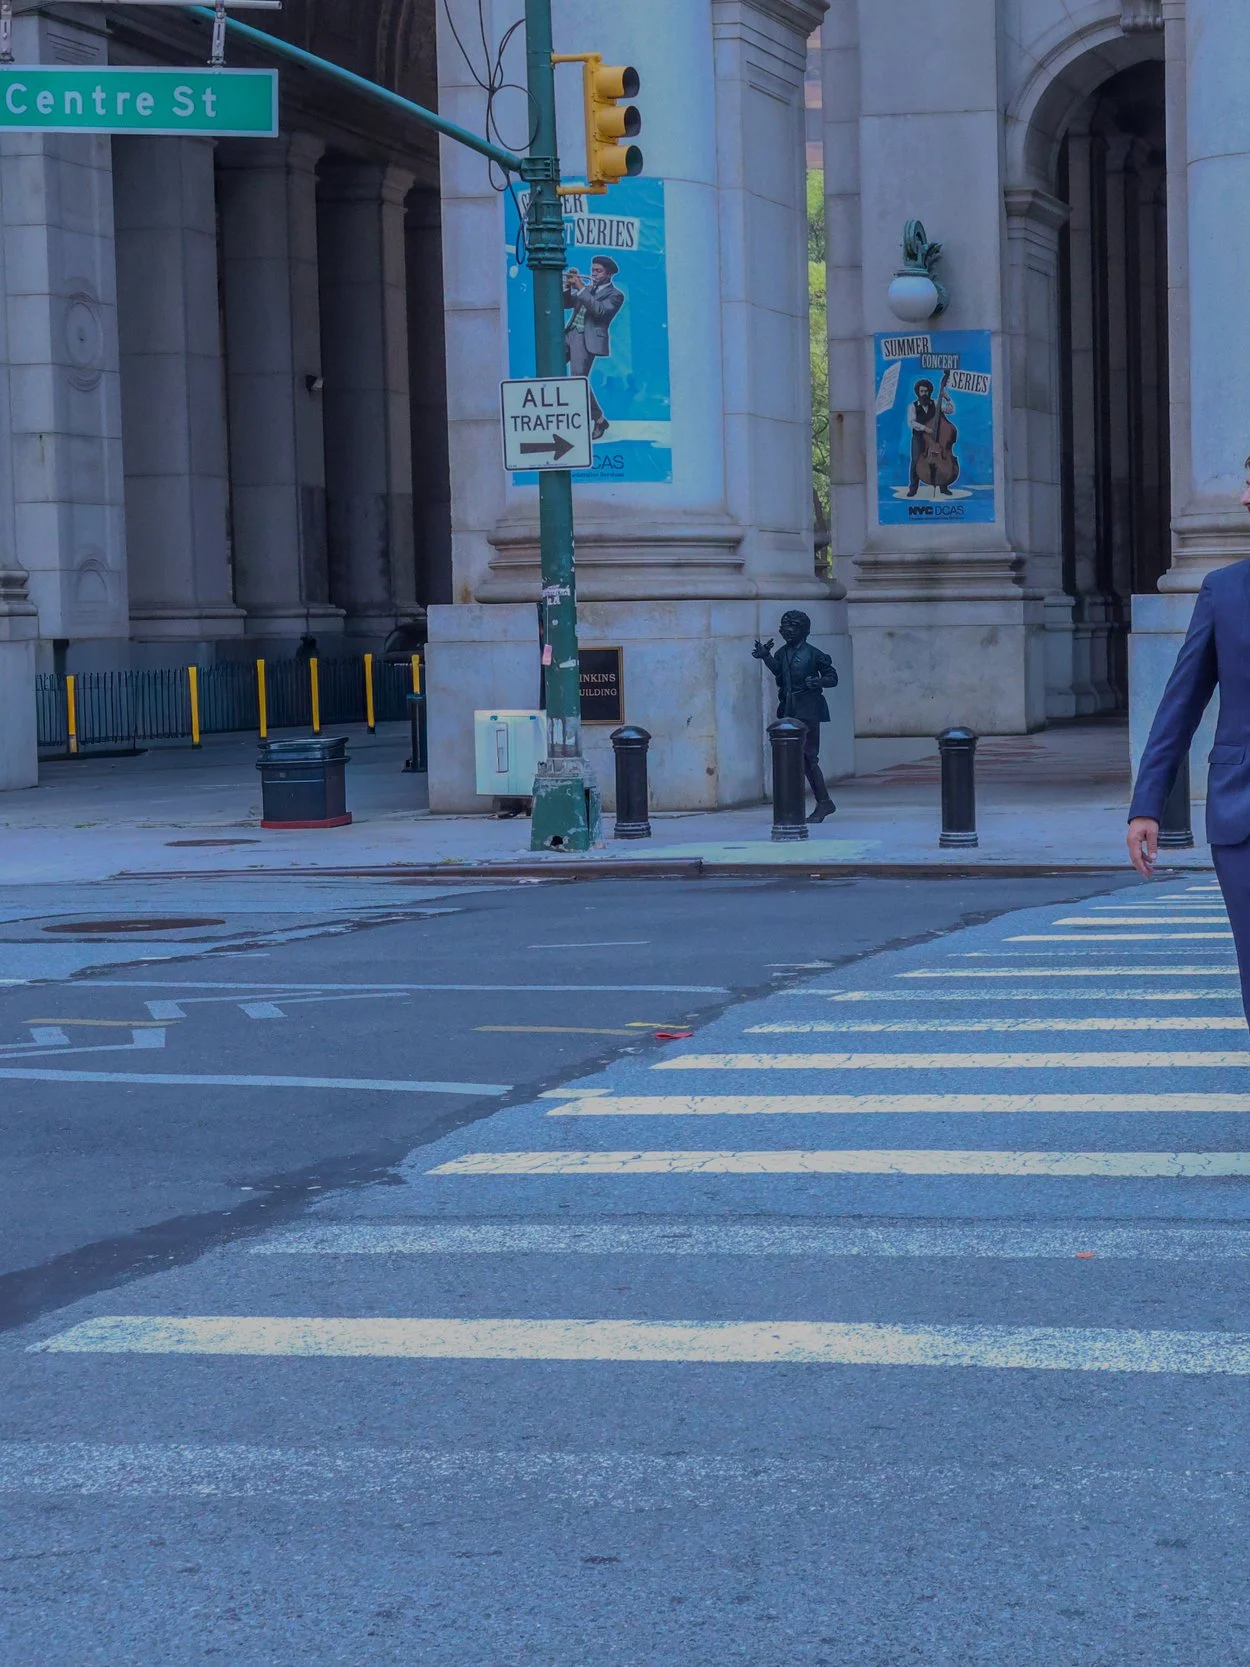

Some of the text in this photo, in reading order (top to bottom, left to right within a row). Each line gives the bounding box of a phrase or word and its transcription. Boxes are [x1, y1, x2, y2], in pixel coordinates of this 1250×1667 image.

[5, 82, 217, 118] Centre St
[576, 218, 635, 247] SERIES
[883, 337, 929, 357] SUMMER
[921, 354, 959, 369] CONCERT
[951, 371, 988, 393] SERIES
[522, 386, 569, 408] ALL
[510, 412, 582, 432] TRAFFIC
[592, 454, 625, 470] CAS
[908, 505, 965, 516] NYC DCAS
[579, 673, 616, 682] INKINS
[579, 688, 617, 696] UILDING
